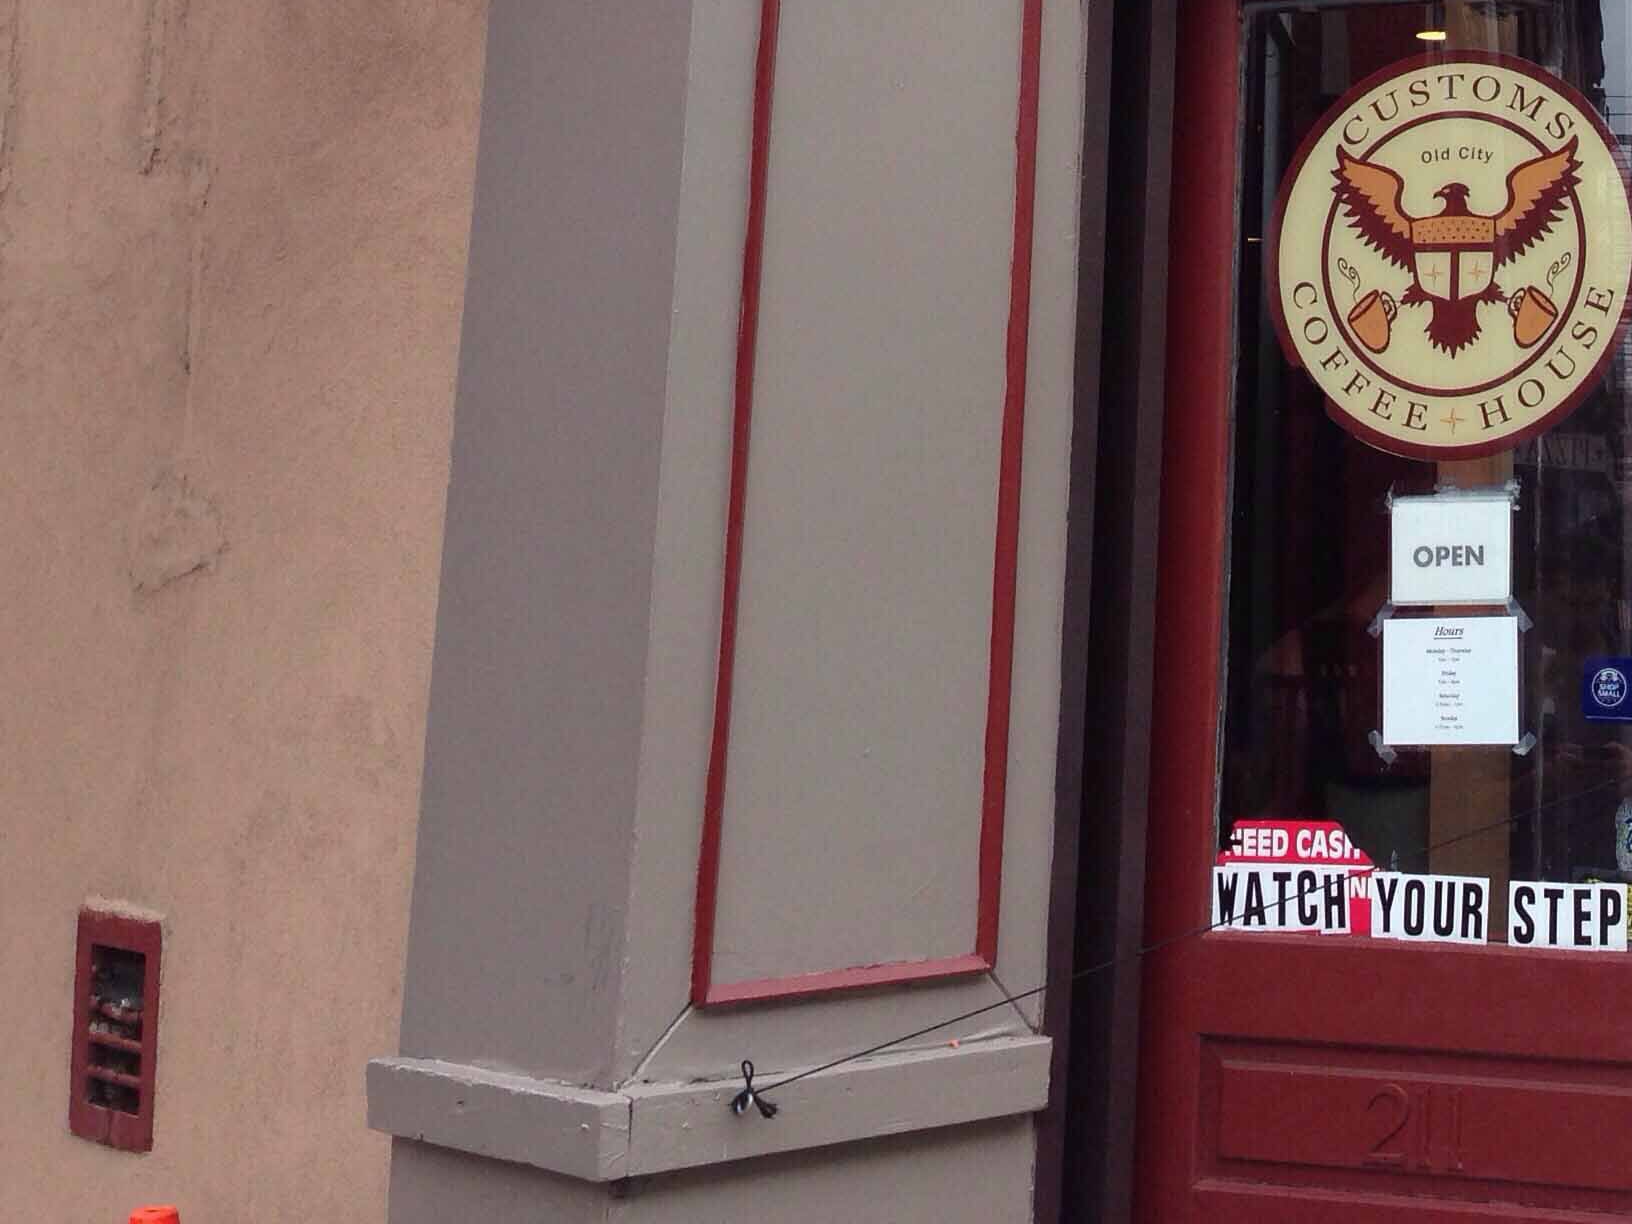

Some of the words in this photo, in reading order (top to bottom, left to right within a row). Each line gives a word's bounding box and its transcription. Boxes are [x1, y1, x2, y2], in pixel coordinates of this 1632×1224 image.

[1342, 74, 1575, 145] CUSTOMS
[1421, 148, 1450, 164] Old
[1458, 146, 1494, 165] City
[1292, 281, 1428, 430] COFFEE
[1478, 287, 1615, 430] HOUSE
[1413, 544, 1485, 569] OPEN
[1434, 625, 1464, 637] Hours
[1597, 690, 1620, 698] SMALL
[1599, 682, 1619, 690] SHOP
[1217, 869, 1347, 930] WATCH
[1375, 876, 1484, 940] YOUR
[1513, 885, 1622, 947] STEP
